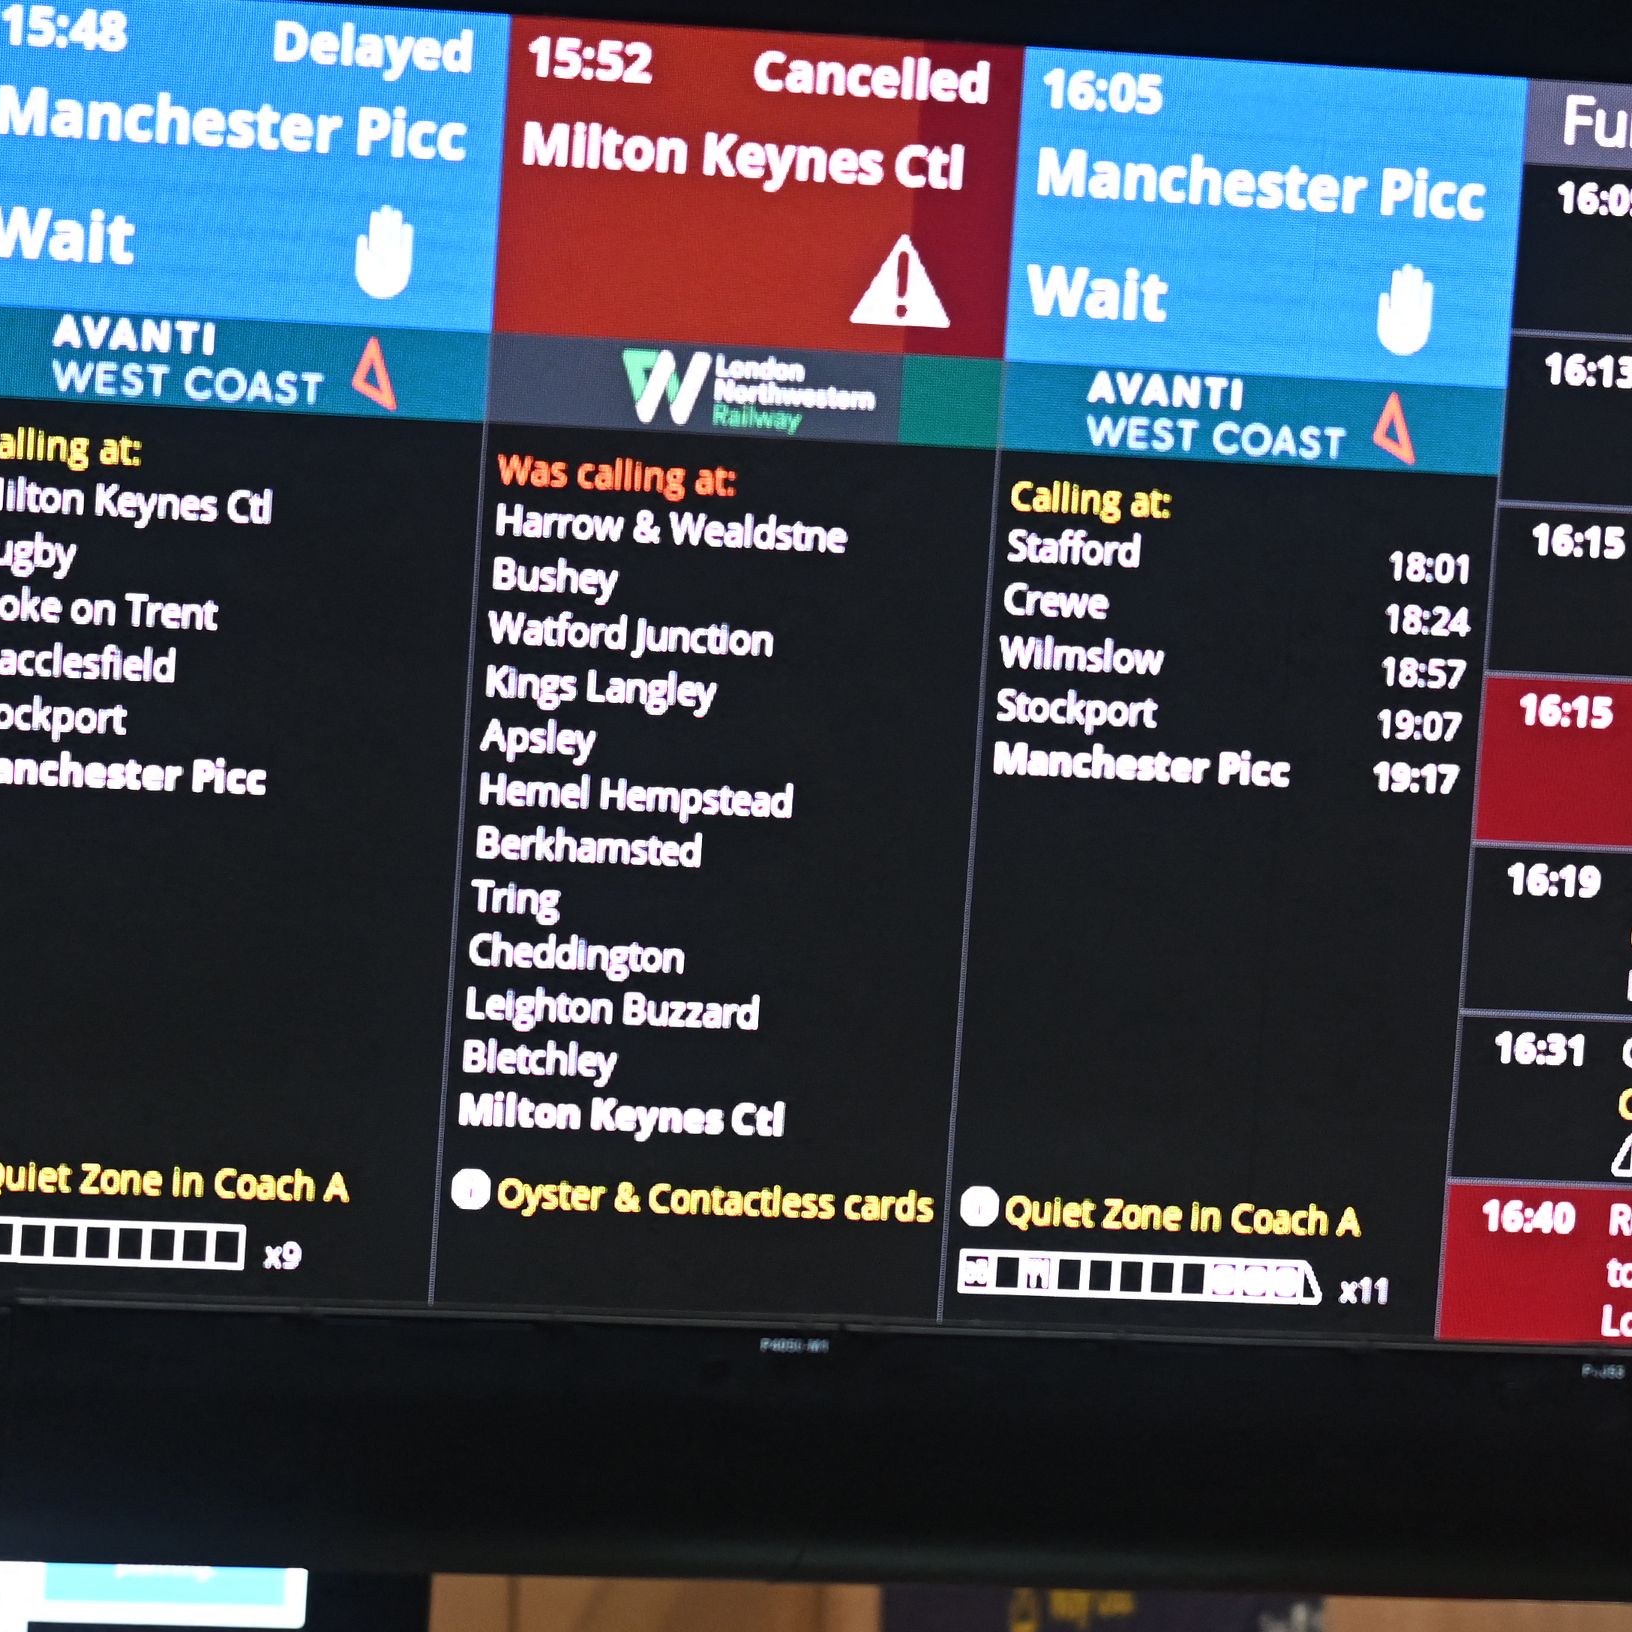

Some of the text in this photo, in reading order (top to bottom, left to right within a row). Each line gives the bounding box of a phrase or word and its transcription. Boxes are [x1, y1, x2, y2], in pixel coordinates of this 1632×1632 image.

[2, 3, 475, 83] 15:48 Delayed
[529, 35, 990, 104] 15:52 Cancelled
[1043, 67, 1164, 116] 16:05
[522, 120, 965, 193] Milton Keynes Ctl
[1036, 146, 1487, 222] Manchester Picc
[499, 456, 734, 500] Was calling at:
[95, 483, 218, 529] Keynes
[227, 489, 273, 524] Ctl
[1007, 528, 1470, 584] Stafford 18:01
[485, 664, 718, 718] Kings Langley
[1520, 693, 1613, 729] 16:15
[1507, 862, 1602, 899] 16:19
[468, 931, 685, 982] Cheddington
[1495, 1030, 1585, 1067] 16:31
[498, 1178, 934, 1223] Oyster & Contactless cards
[1483, 1199, 1576, 1234] 16:40
